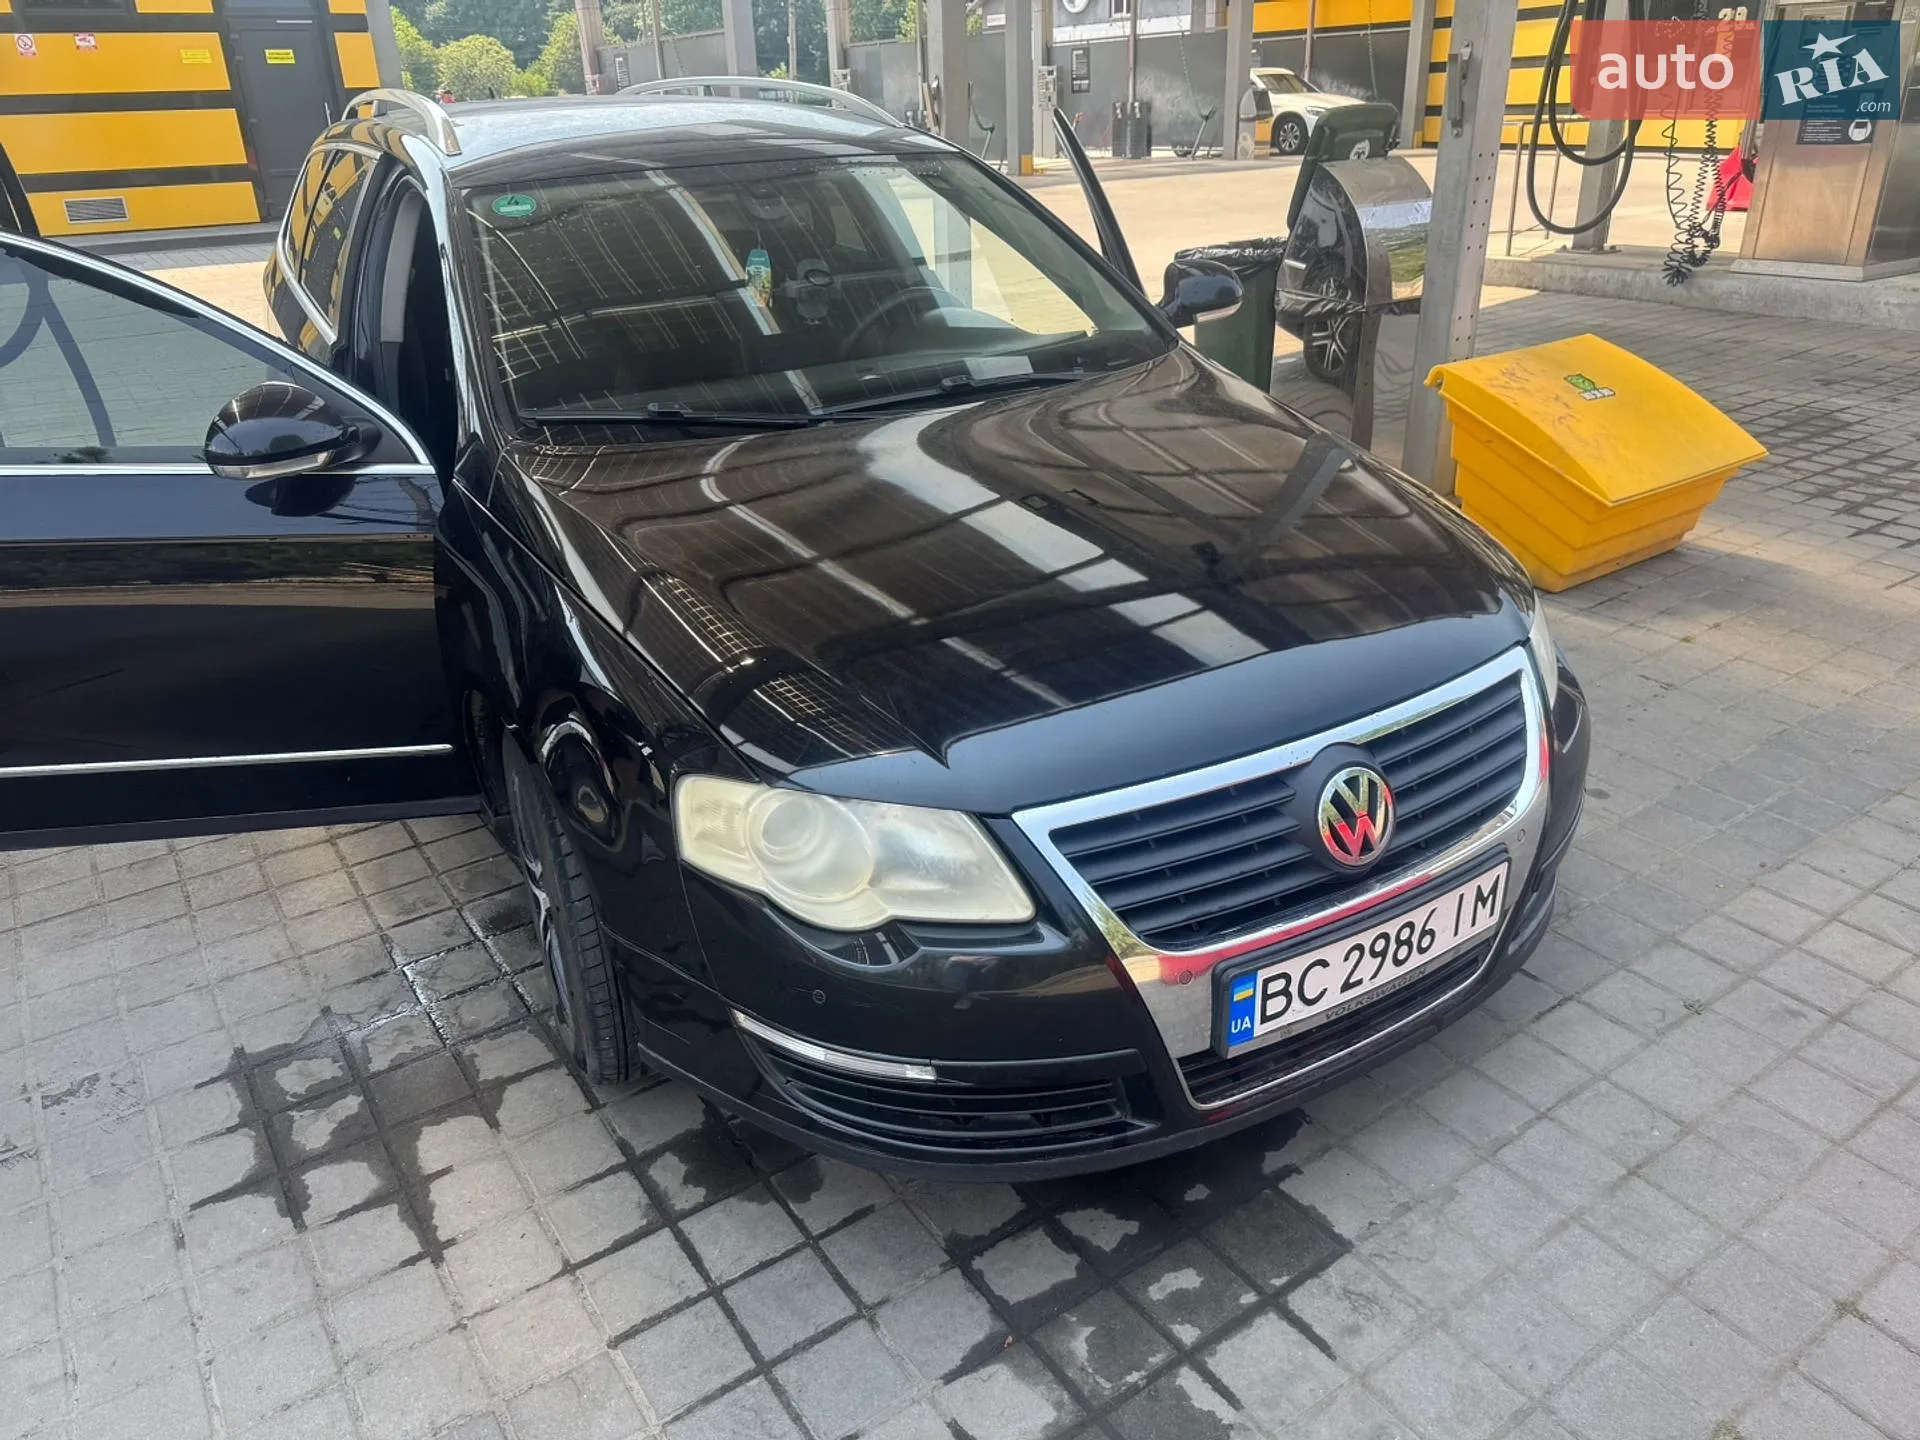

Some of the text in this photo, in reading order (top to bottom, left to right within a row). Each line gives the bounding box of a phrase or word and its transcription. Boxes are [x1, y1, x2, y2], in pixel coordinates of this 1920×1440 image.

[1260, 874, 1500, 1026] BC 2986 IM
[1231, 1018, 1252, 1034] UA
